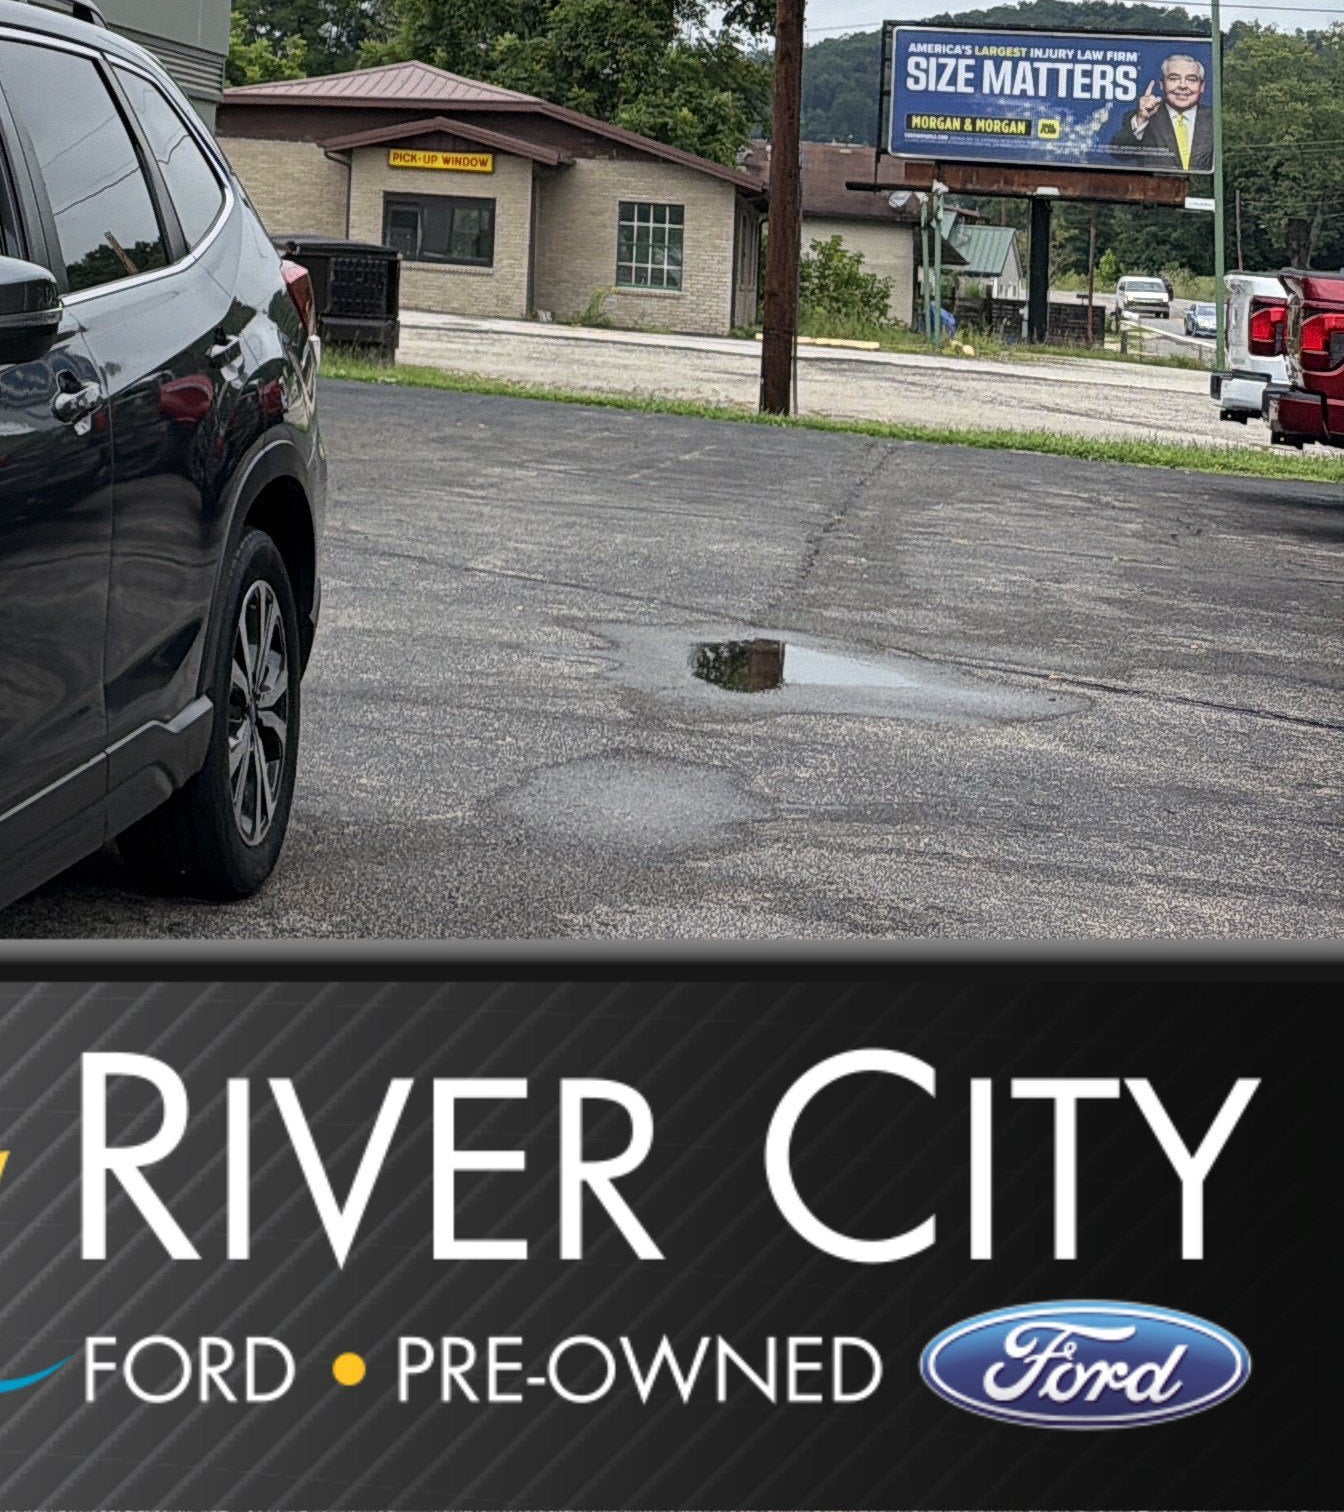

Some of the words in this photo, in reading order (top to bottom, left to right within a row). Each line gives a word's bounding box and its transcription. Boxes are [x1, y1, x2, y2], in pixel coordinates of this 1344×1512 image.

[908, 42, 972, 56] AMERICA'S
[974, 45, 1027, 58] LARGEST
[1030, 48, 1075, 59] INJURY
[1077, 49, 1104, 61] LAW
[1106, 50, 1138, 62] FIRM
[906, 55, 976, 94] SIZE
[982, 59, 1138, 101] MATTERS
[912, 115, 961, 131] MORGAN
[963, 117, 973, 132] &
[975, 118, 1026, 134] MORGAN
[392, 152, 438, 164] PICK-UP
[441, 155, 489, 168] WINDOW
